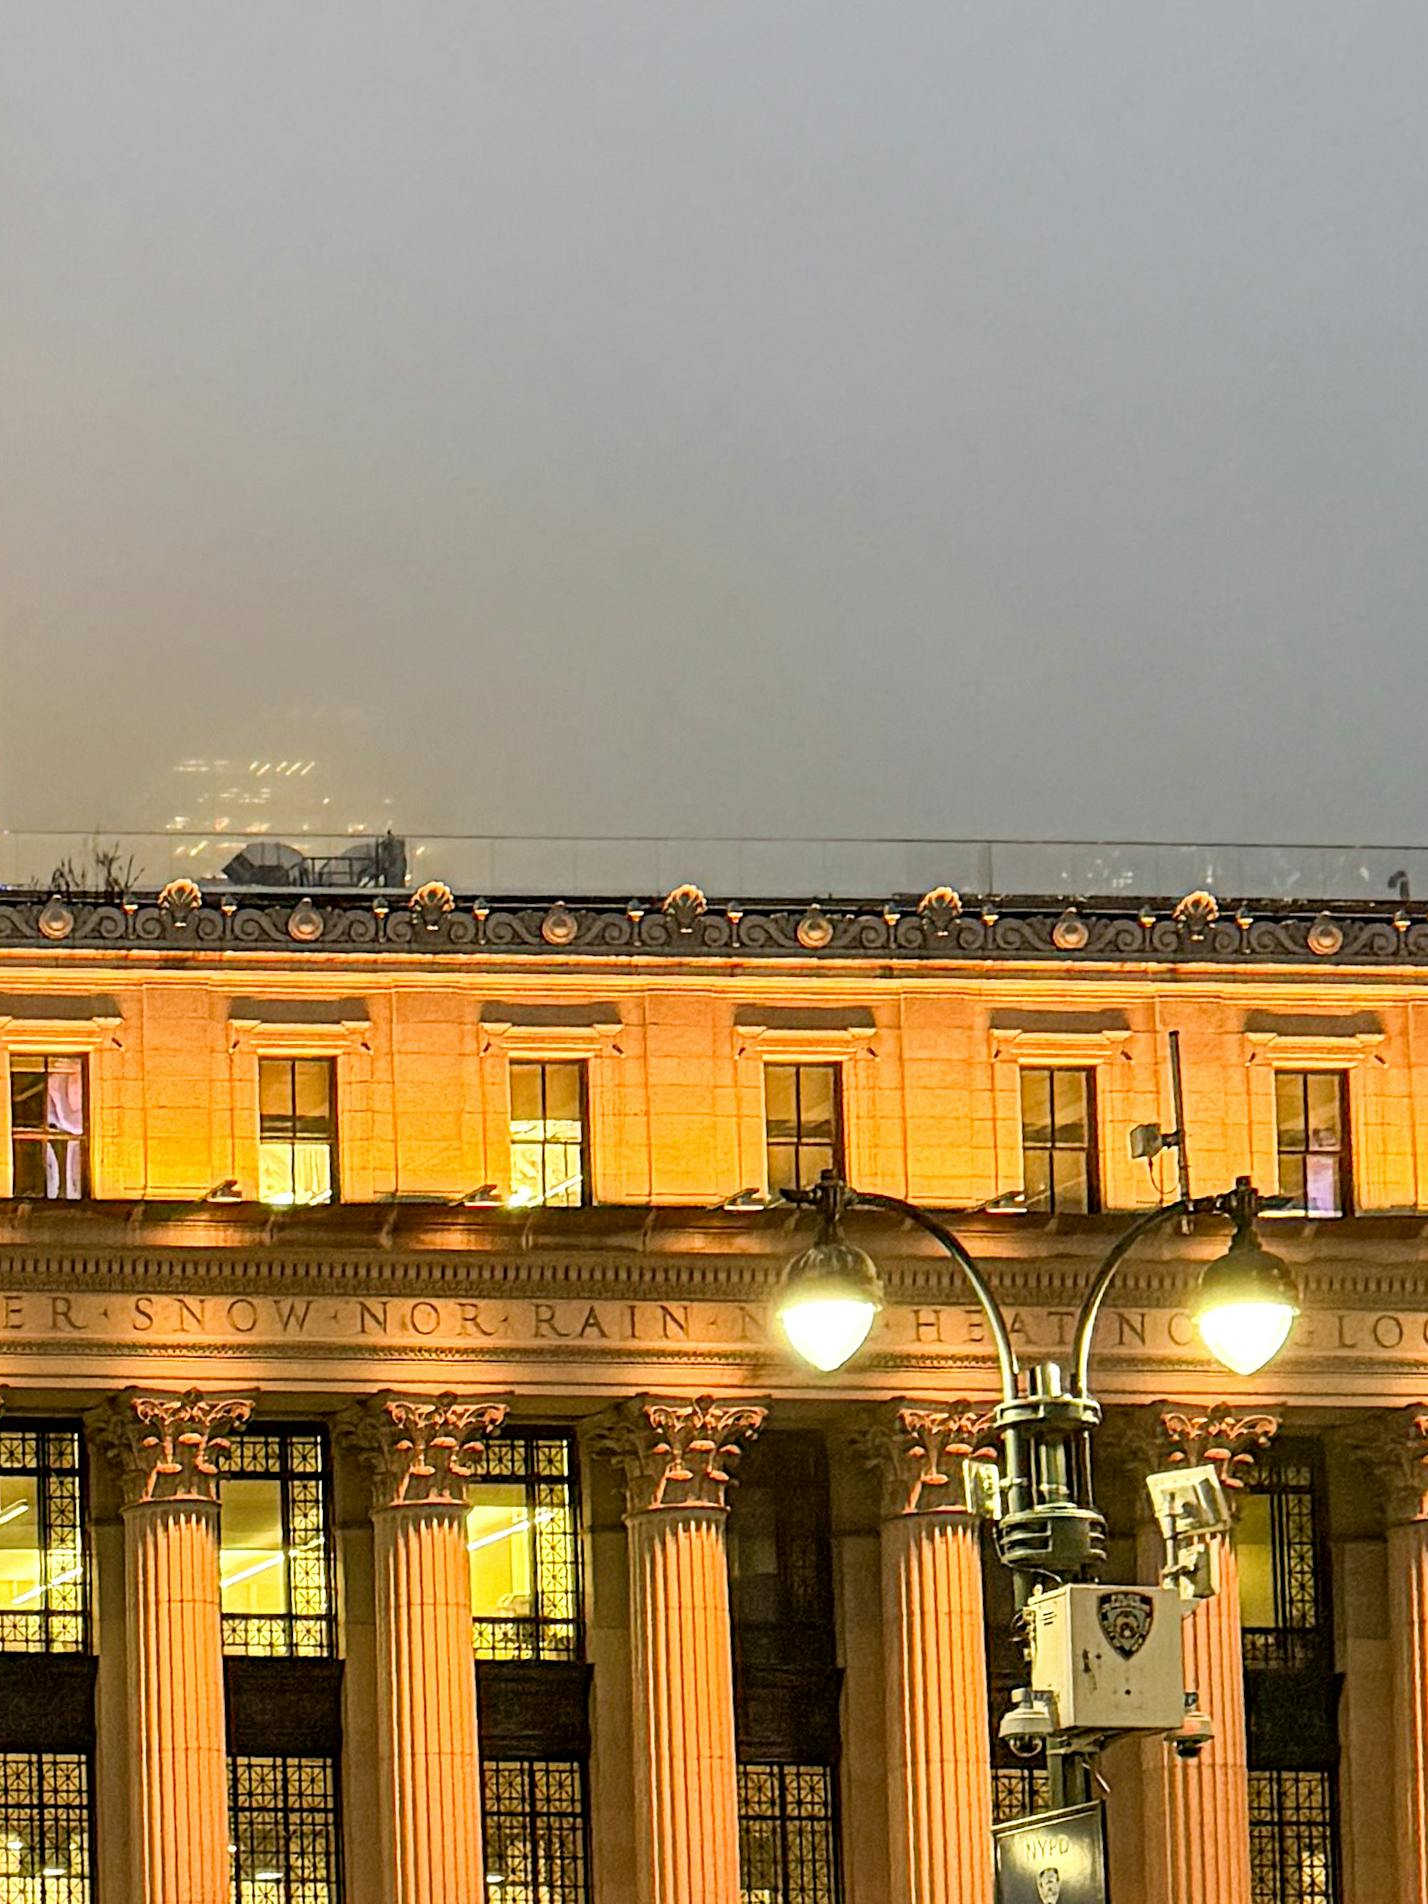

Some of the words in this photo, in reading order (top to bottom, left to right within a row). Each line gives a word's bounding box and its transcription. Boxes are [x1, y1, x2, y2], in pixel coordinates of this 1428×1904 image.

[131, 1297, 315, 1333] SNOW
[358, 1300, 496, 1336] NOR
[532, 1302, 690, 1339] RAIN
[911, 1308, 1075, 1346] HEAT
[1291, 1312, 1428, 1349] GLO
[1025, 1837, 1071, 1861] NYPD
